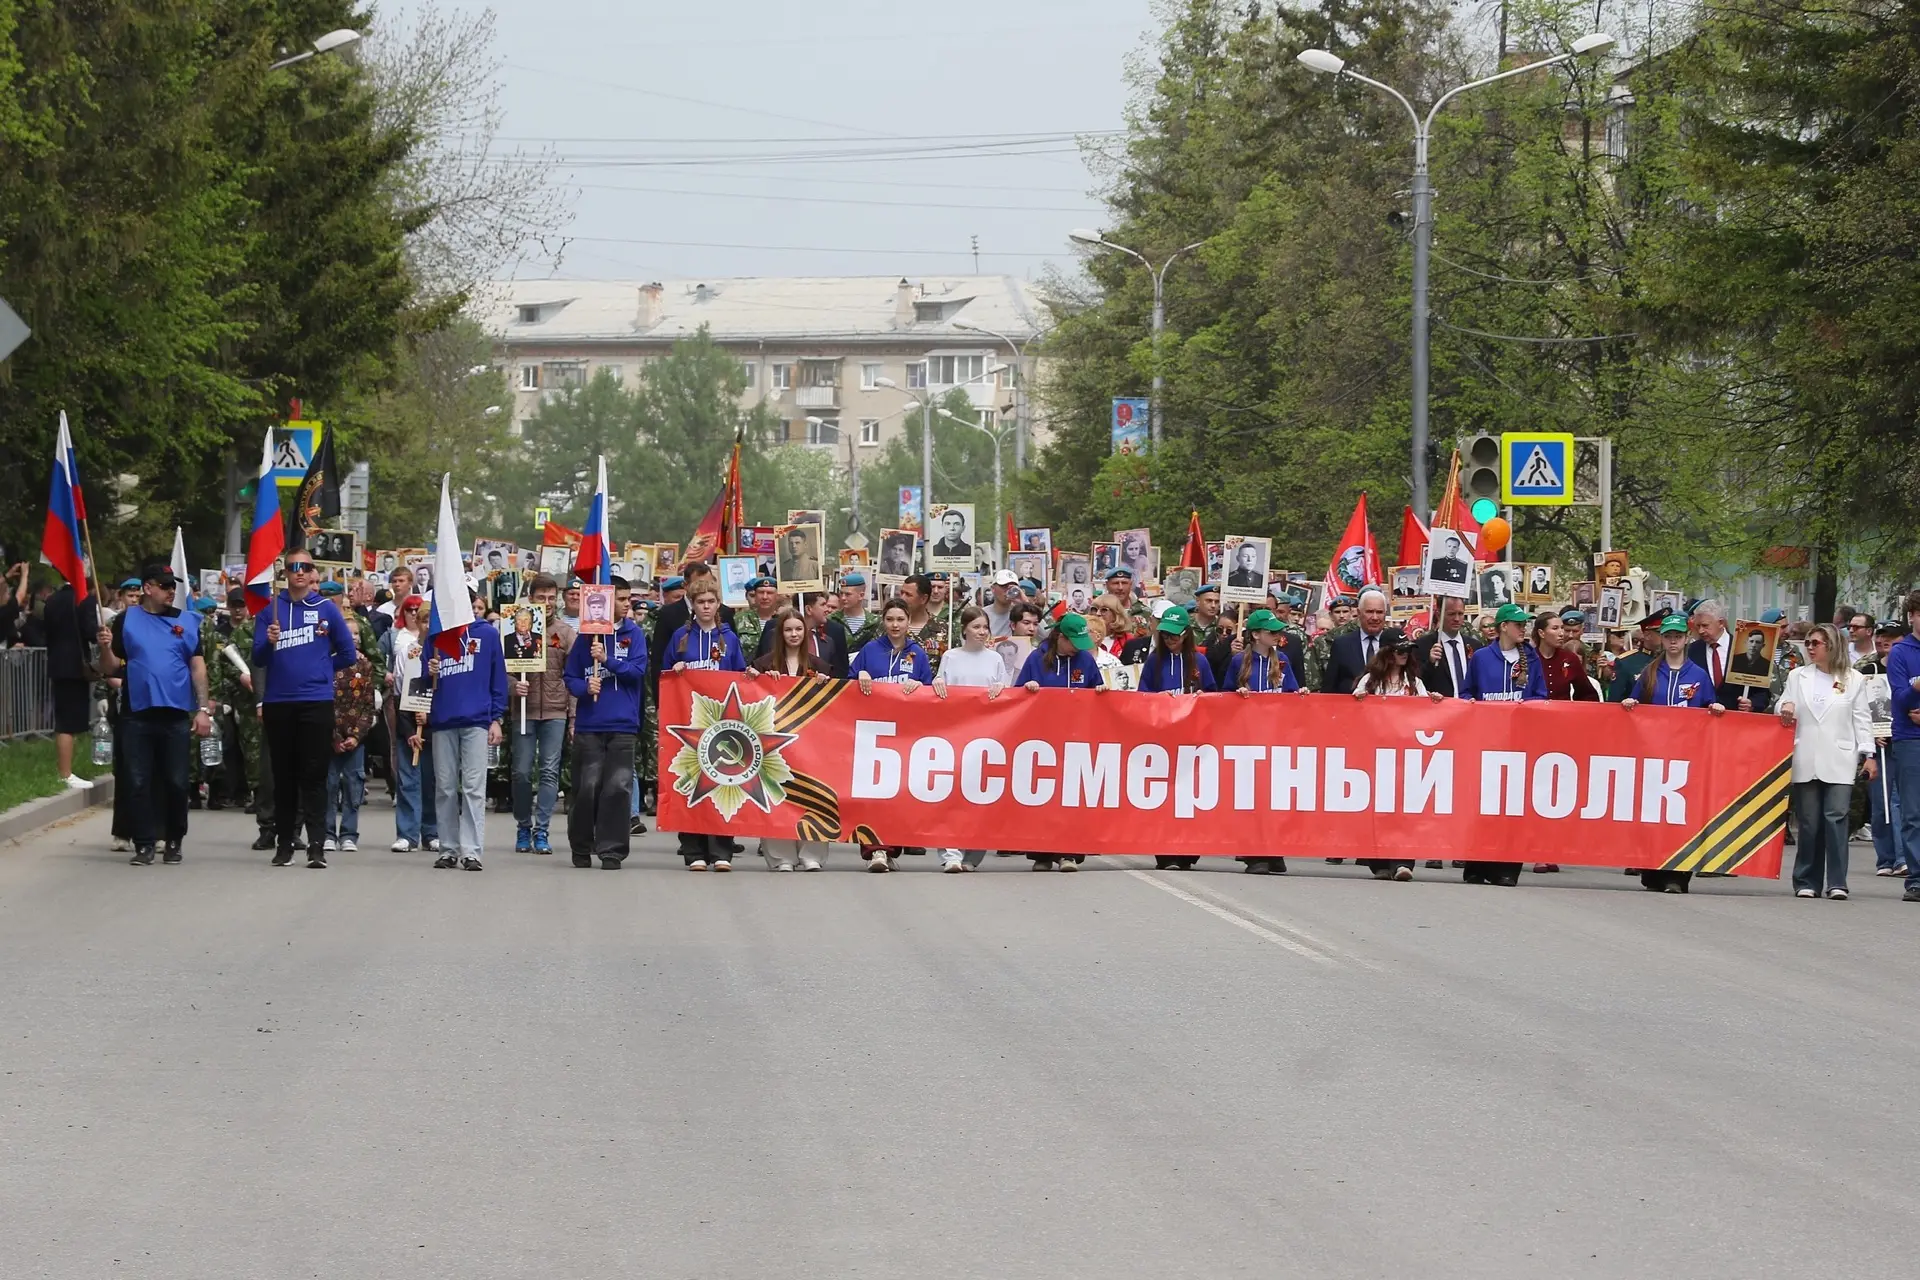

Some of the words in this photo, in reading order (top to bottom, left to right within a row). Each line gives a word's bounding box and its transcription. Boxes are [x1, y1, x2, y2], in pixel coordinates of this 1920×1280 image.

[700, 722, 757, 778] ОТЕЧЕСТВЕННАЯ
[852, 719, 1454, 819] Бессмертный
[1480, 751, 1690, 825] полк
